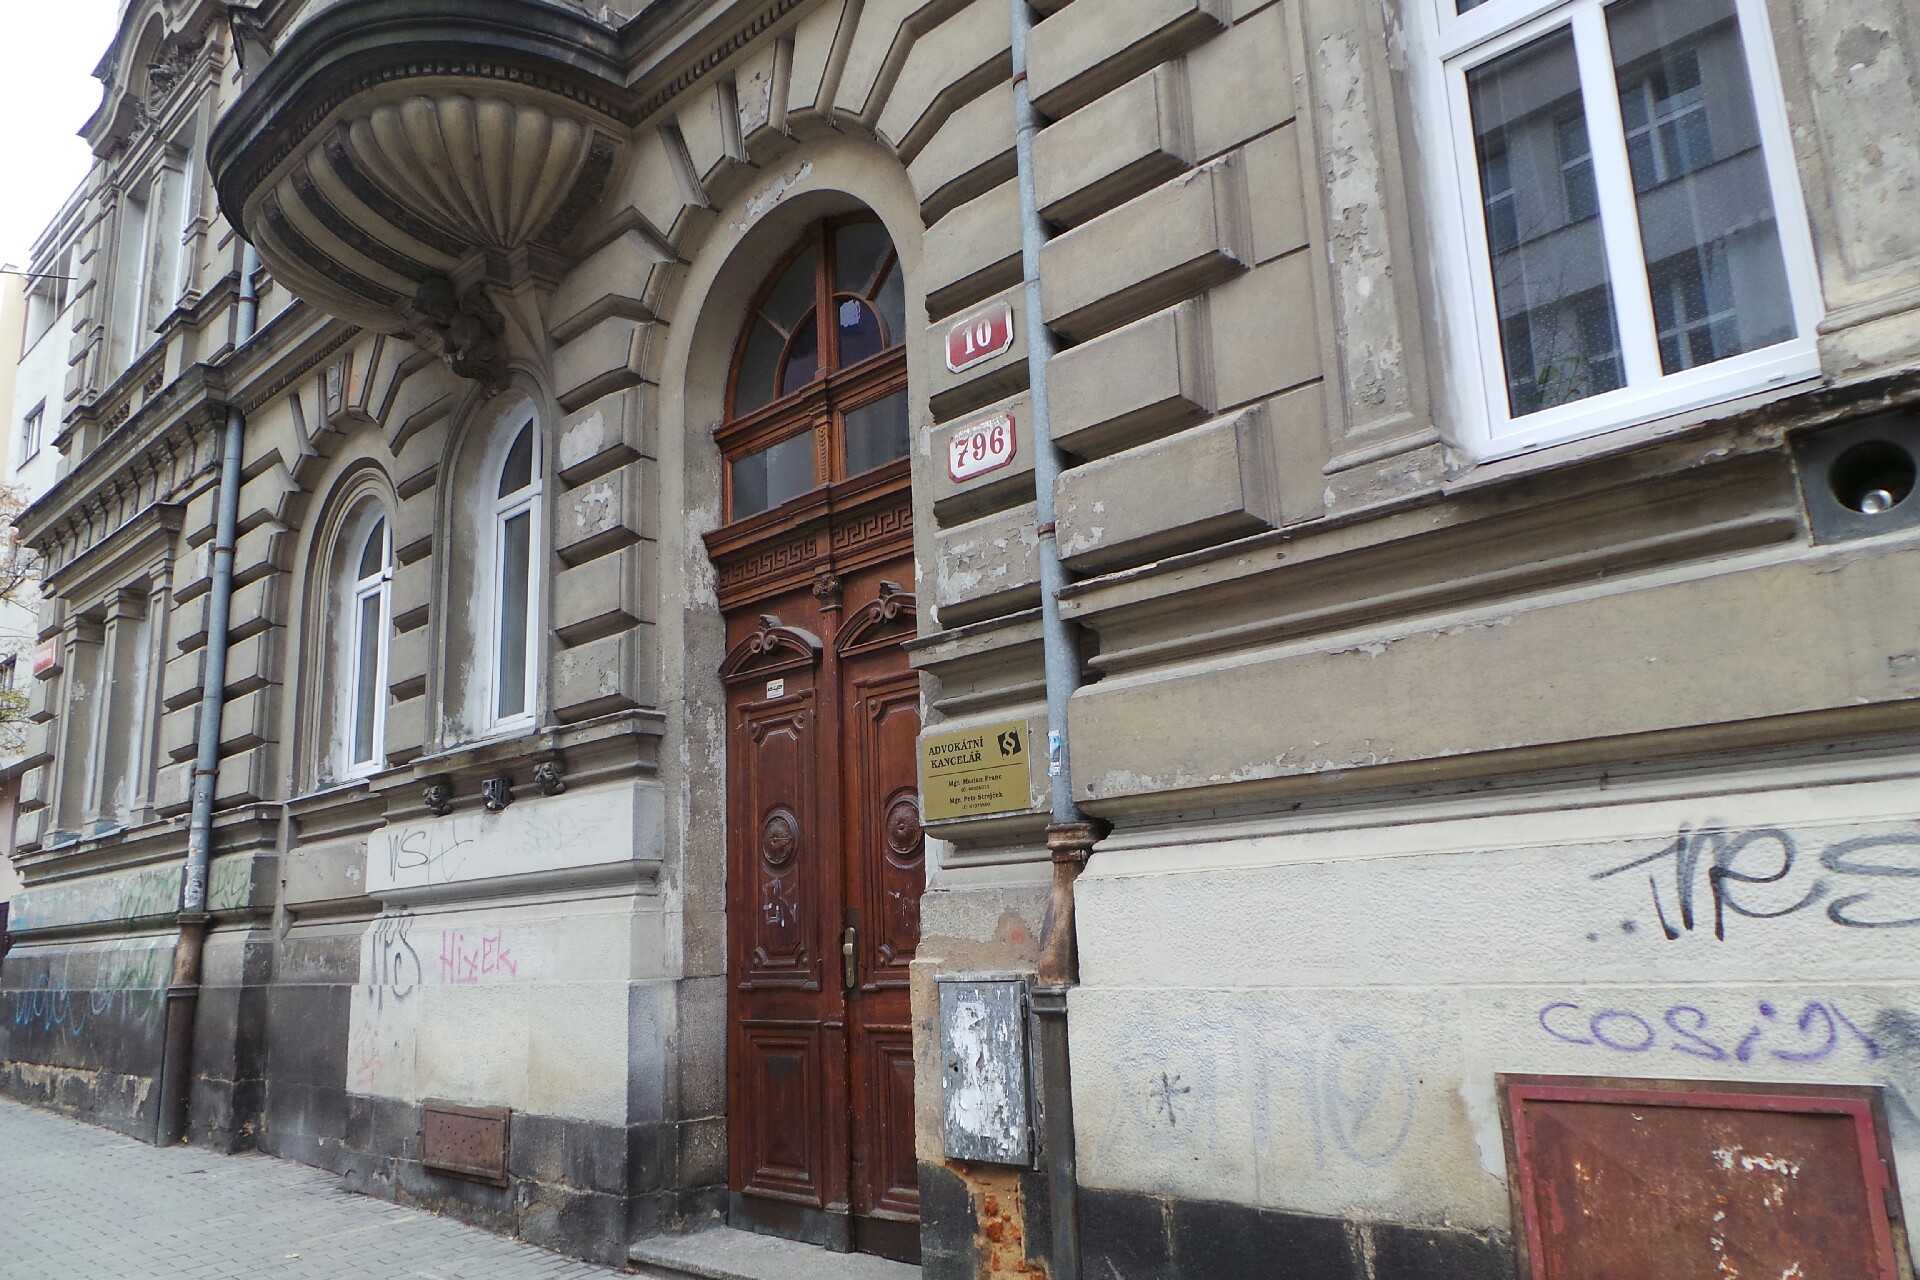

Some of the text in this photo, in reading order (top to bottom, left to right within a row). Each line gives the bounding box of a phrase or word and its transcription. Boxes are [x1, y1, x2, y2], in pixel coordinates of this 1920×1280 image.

[962, 318, 992, 355] 10
[955, 426, 1005, 468] 796
[929, 736, 983, 755] ADVOKÁTNÍ
[931, 752, 981, 768] KANCELÁŘ
